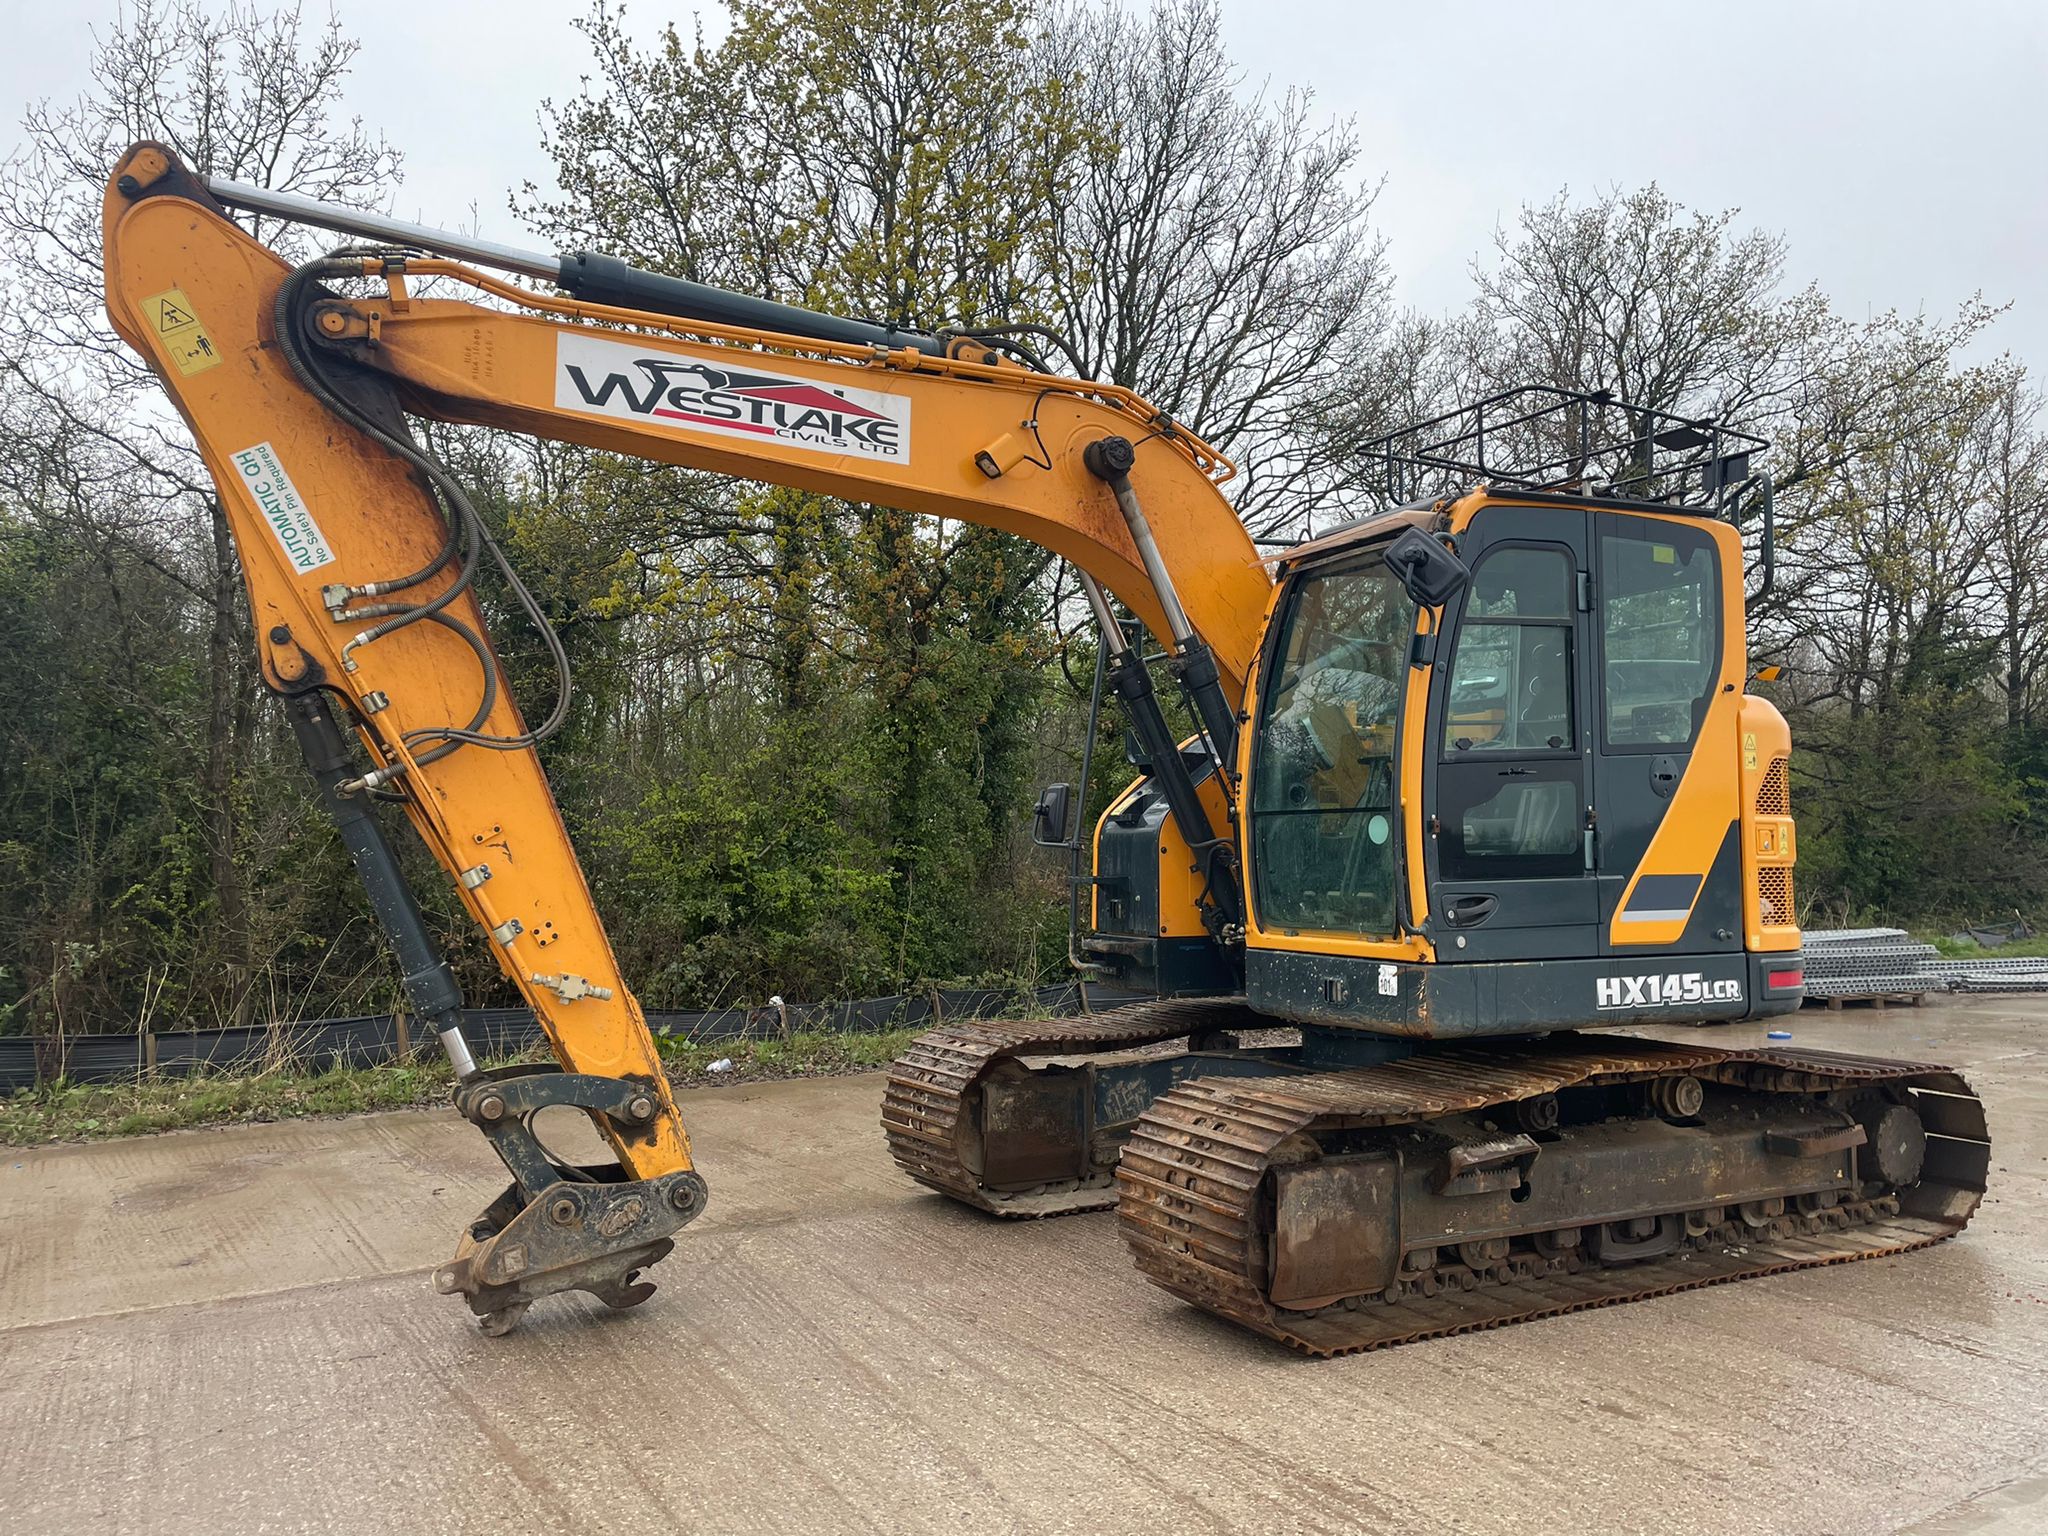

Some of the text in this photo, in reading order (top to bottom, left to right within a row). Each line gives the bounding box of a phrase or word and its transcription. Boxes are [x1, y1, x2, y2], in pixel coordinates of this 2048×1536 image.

[565, 360, 899, 448] WESTLAKE
[774, 428, 898, 455] CIVILS LTD
[236, 451, 315, 567] AUTOMATIC QH
[255, 446, 329, 563] No Safety Pin Required
[1596, 972, 1742, 1009] HX145LCR
